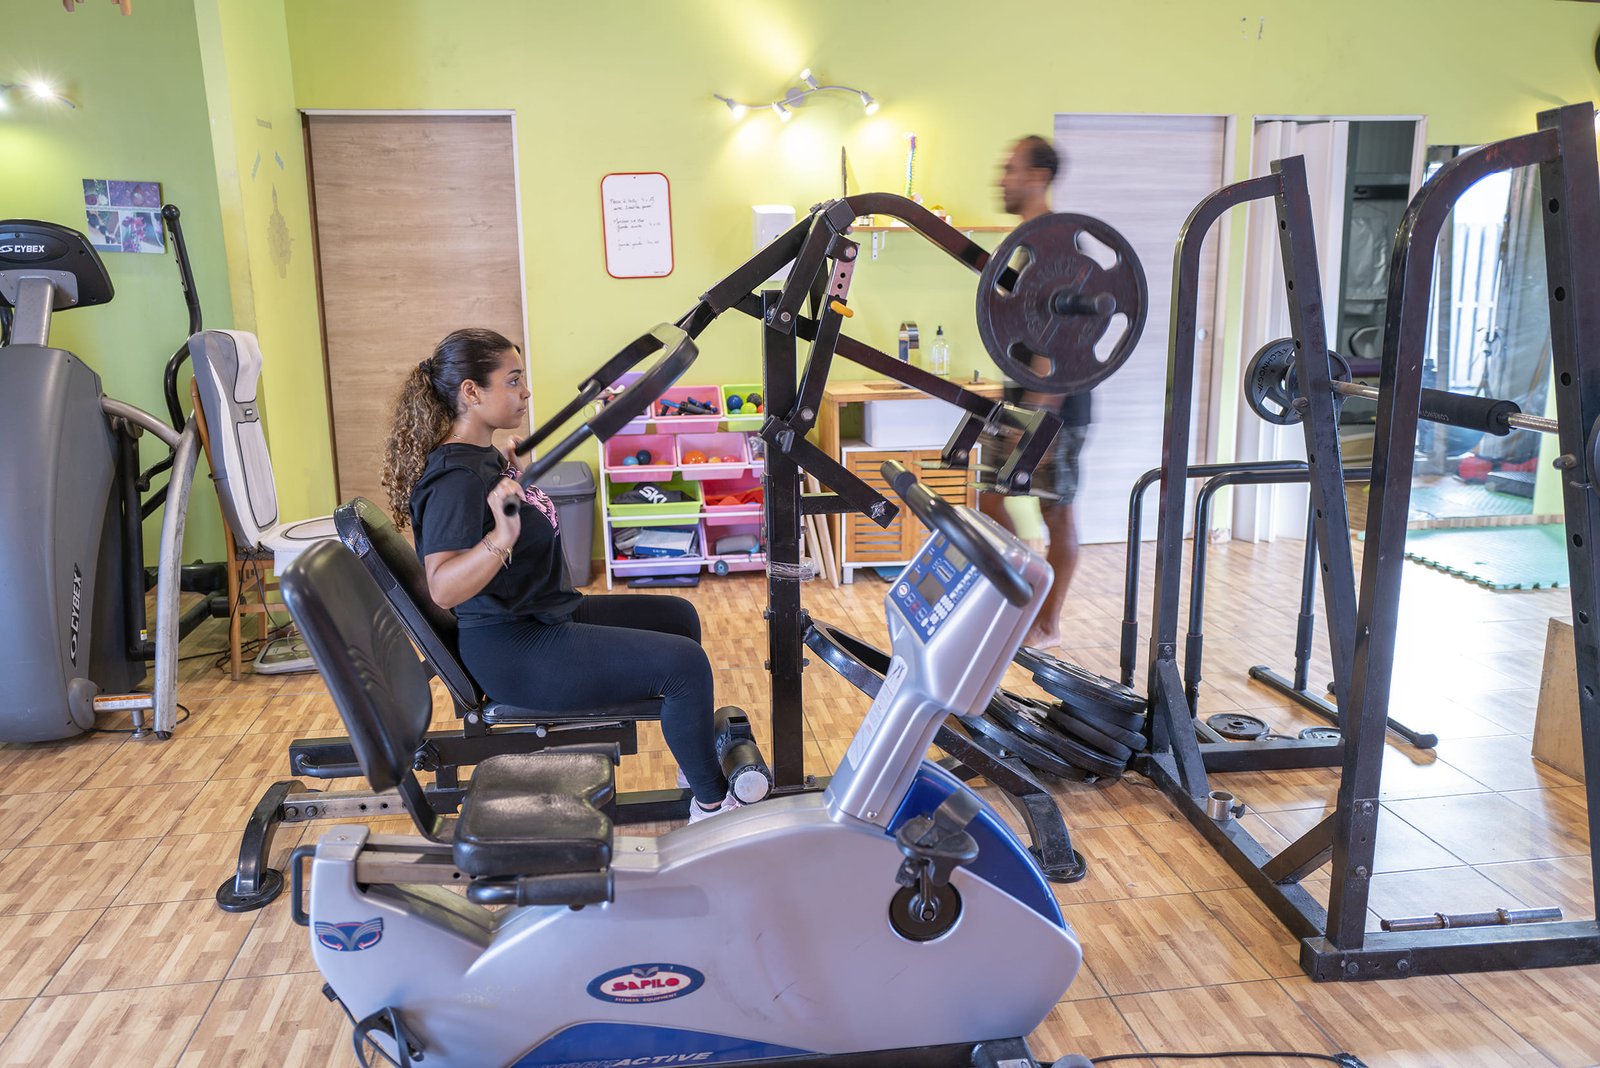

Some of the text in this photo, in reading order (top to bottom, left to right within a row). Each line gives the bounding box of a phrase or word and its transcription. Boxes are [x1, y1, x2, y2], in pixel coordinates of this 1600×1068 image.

[14, 244, 45, 253] CYBEX
[70, 571, 82, 633] CYBEX
[612, 977, 680, 992] SAPILO
